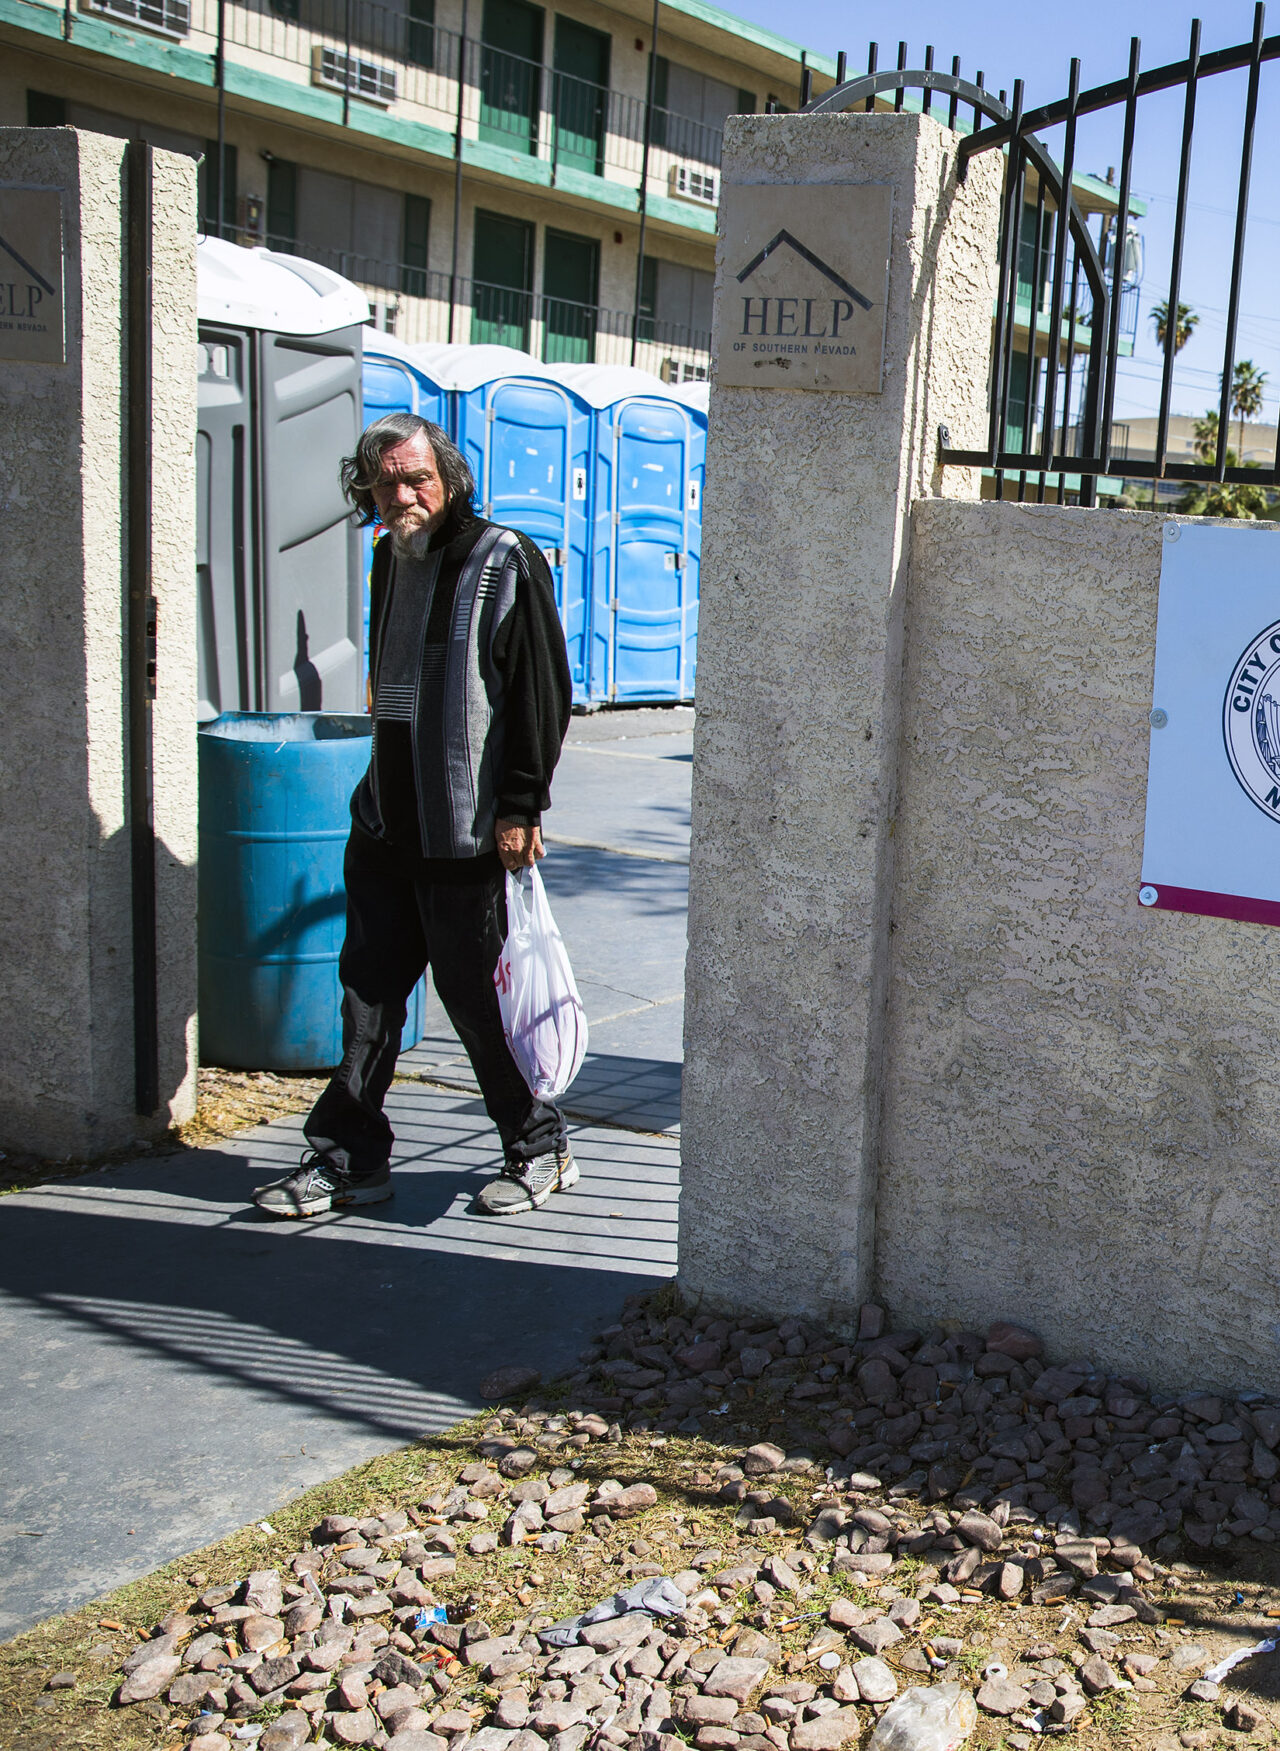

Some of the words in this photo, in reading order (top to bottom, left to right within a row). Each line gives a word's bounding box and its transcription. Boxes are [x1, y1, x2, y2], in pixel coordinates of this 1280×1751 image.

[0, 283, 43, 318] LP
[738, 297, 855, 338] HELP
[733, 342, 747, 352] OF
[752, 342, 808, 354] SOUTHERN
[814, 344, 857, 356] NEVADA
[1232, 652, 1267, 713] CITY
